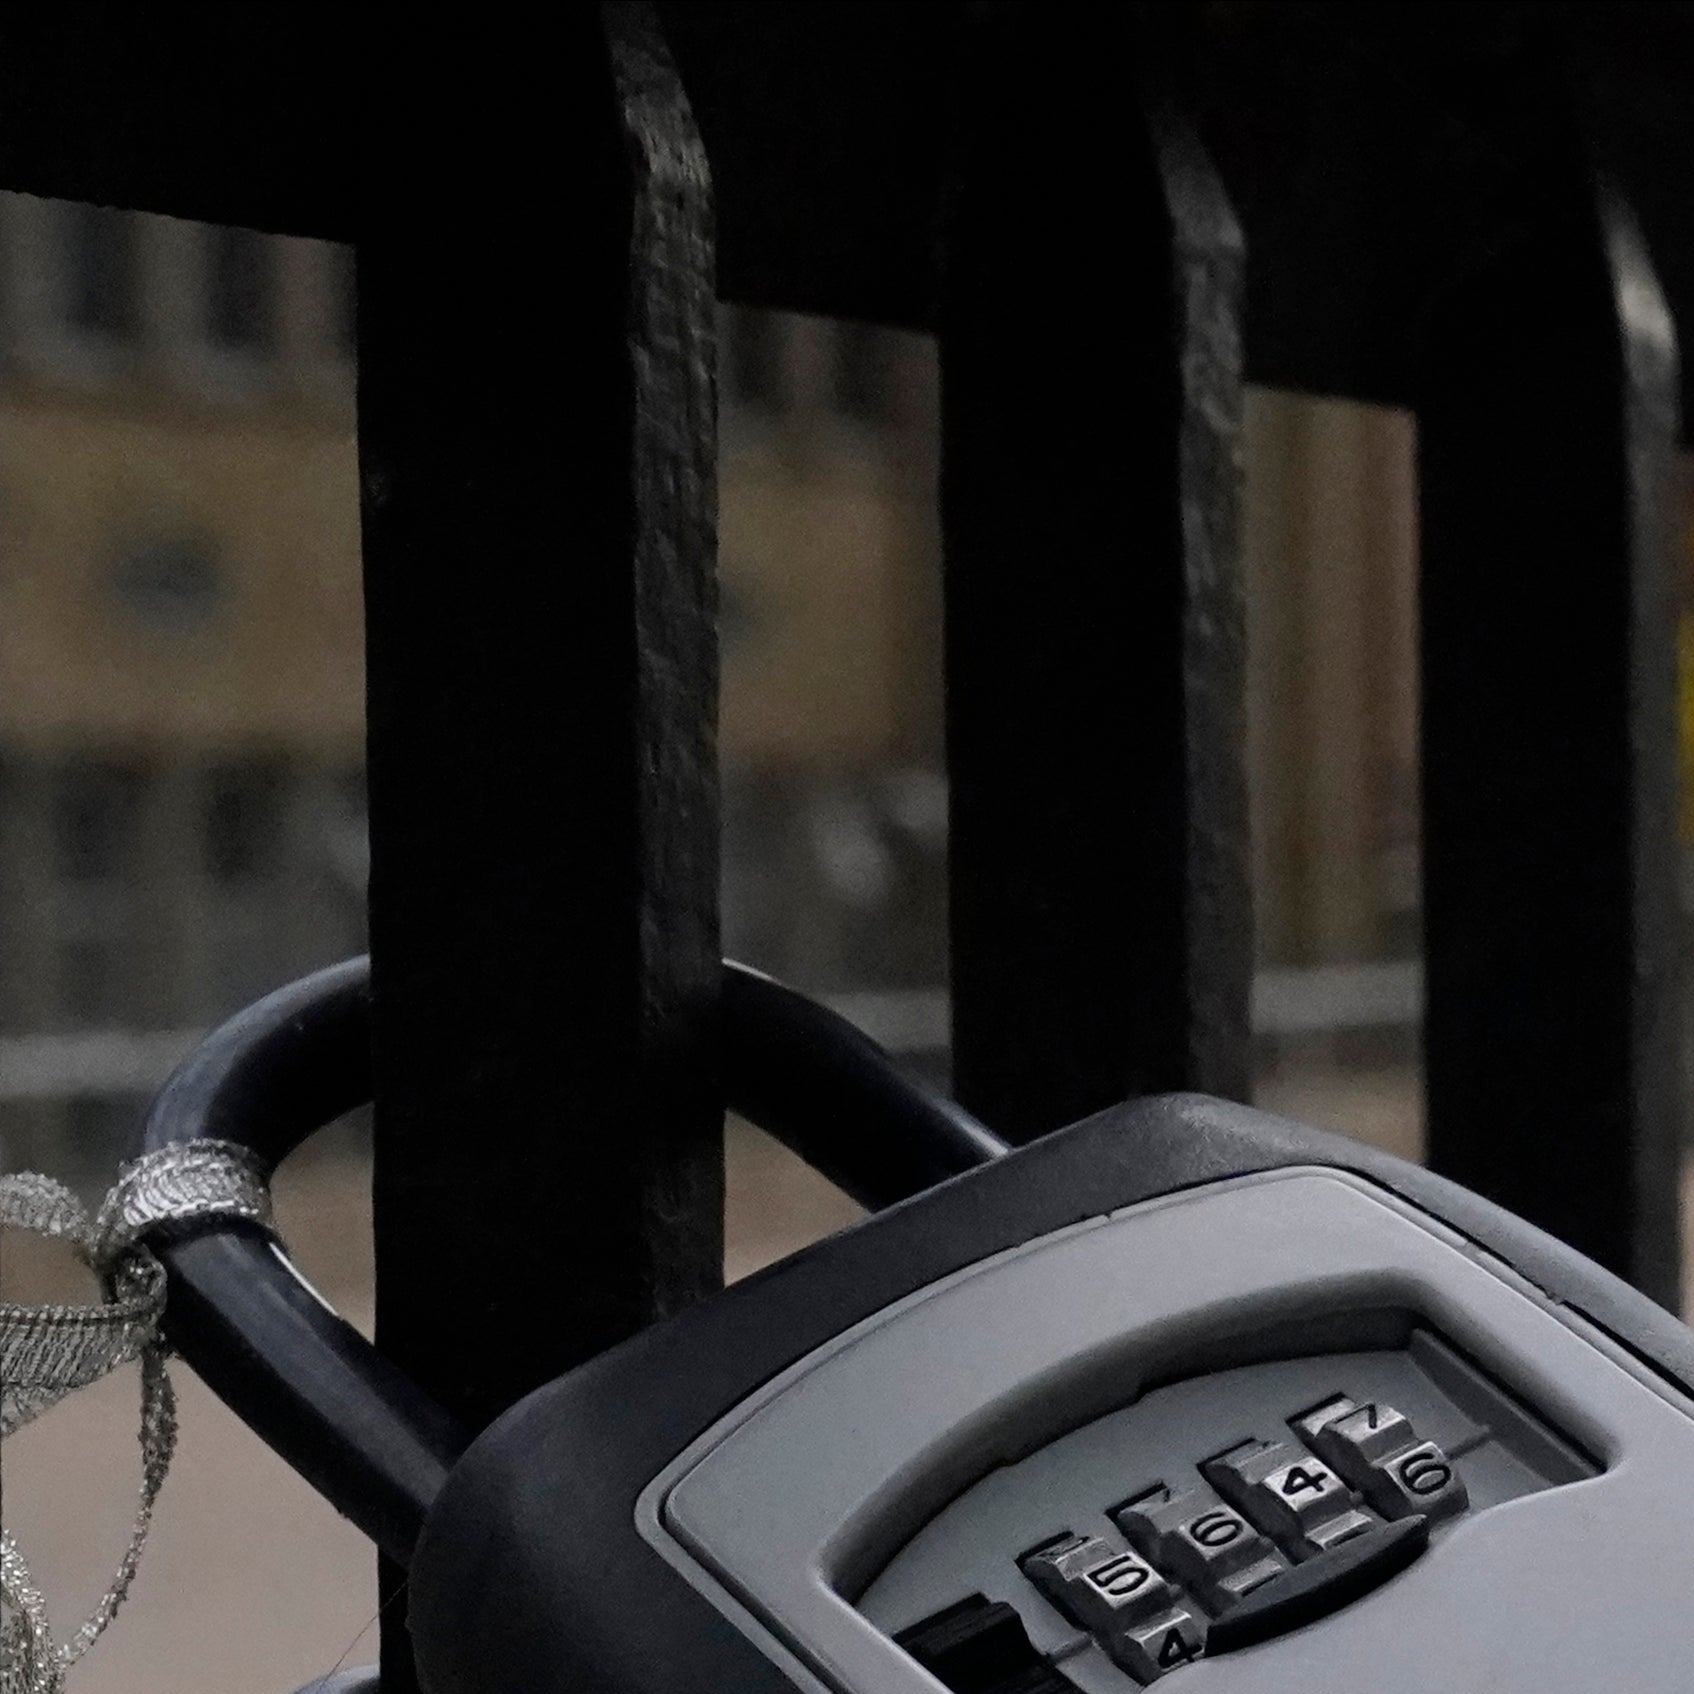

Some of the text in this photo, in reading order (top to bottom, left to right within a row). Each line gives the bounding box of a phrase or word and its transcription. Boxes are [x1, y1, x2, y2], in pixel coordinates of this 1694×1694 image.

[1087, 1451, 1452, 1597] 5 6 4 6
[1157, 1626, 1205, 1669] 4
